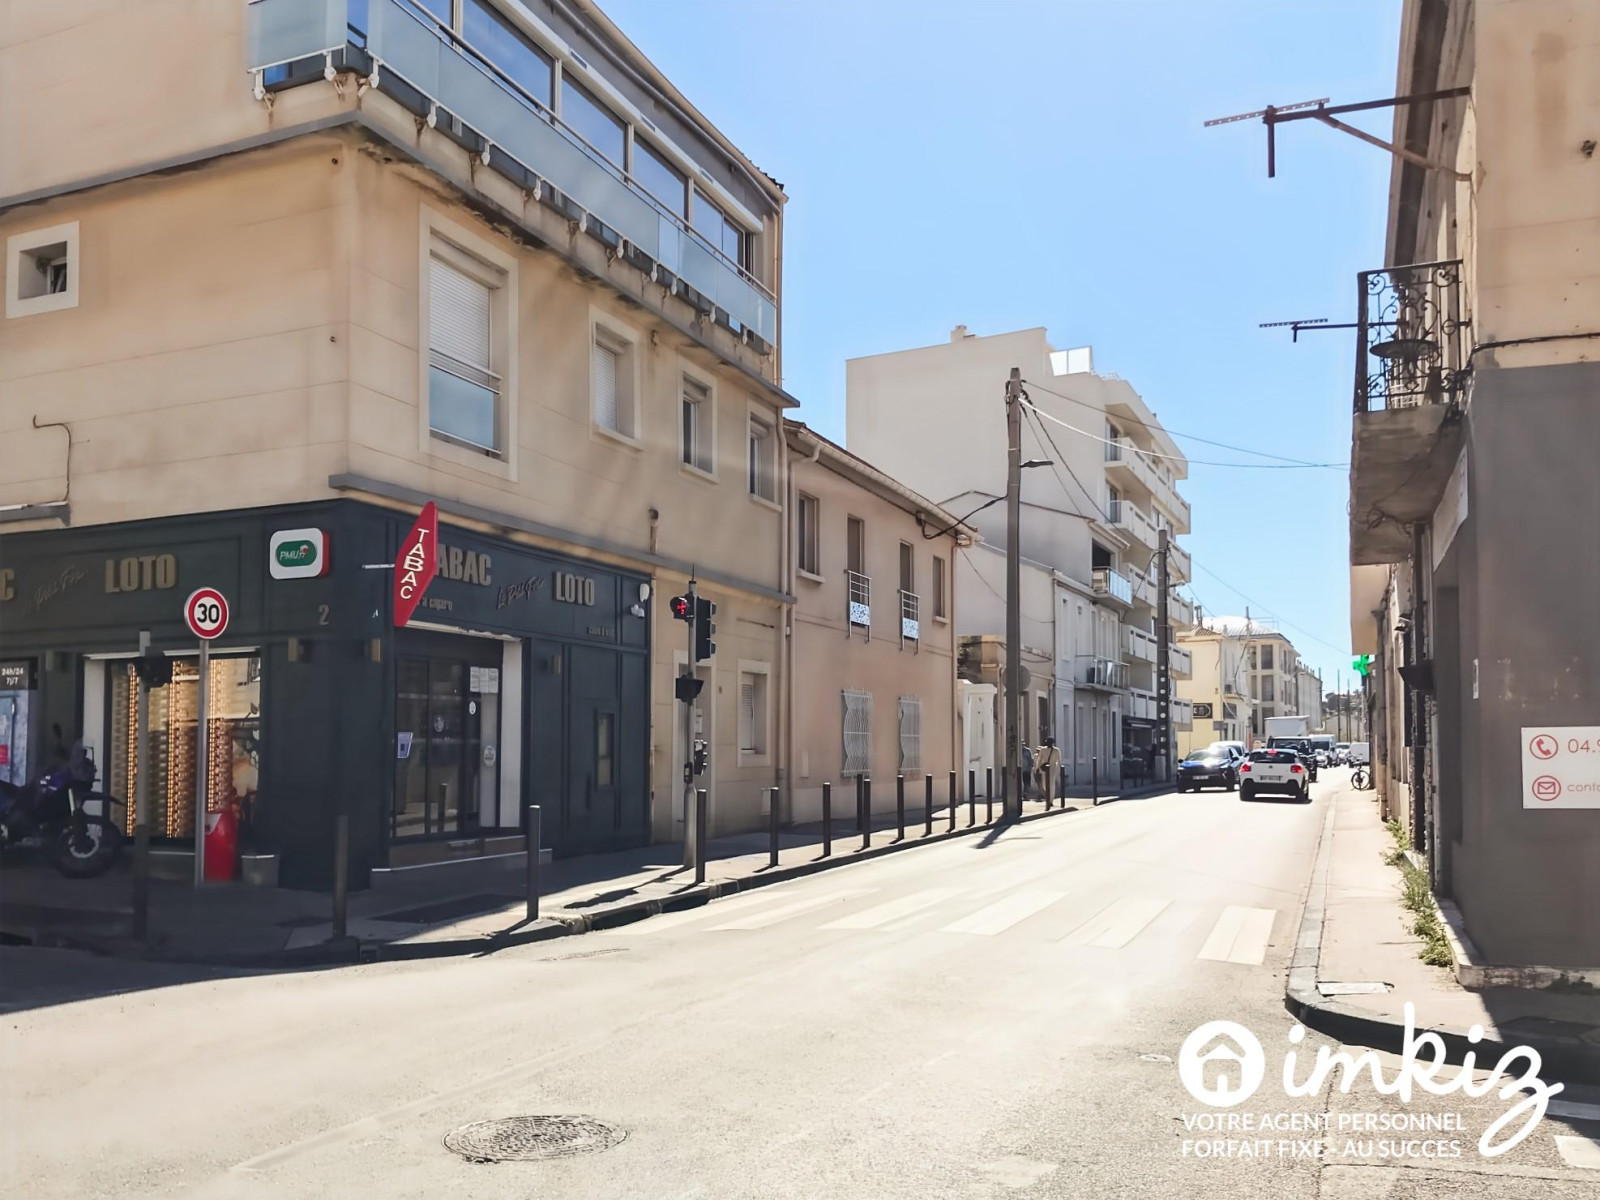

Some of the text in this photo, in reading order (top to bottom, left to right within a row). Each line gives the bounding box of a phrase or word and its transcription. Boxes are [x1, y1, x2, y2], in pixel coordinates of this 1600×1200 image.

[105, 554, 176, 593] LOTO
[401, 528, 430, 600] TABAC
[437, 543, 492, 586] ABAC
[555, 571, 596, 607] LOTO
[197, 603, 220, 624] 30
[318, 604, 330, 625] 2
